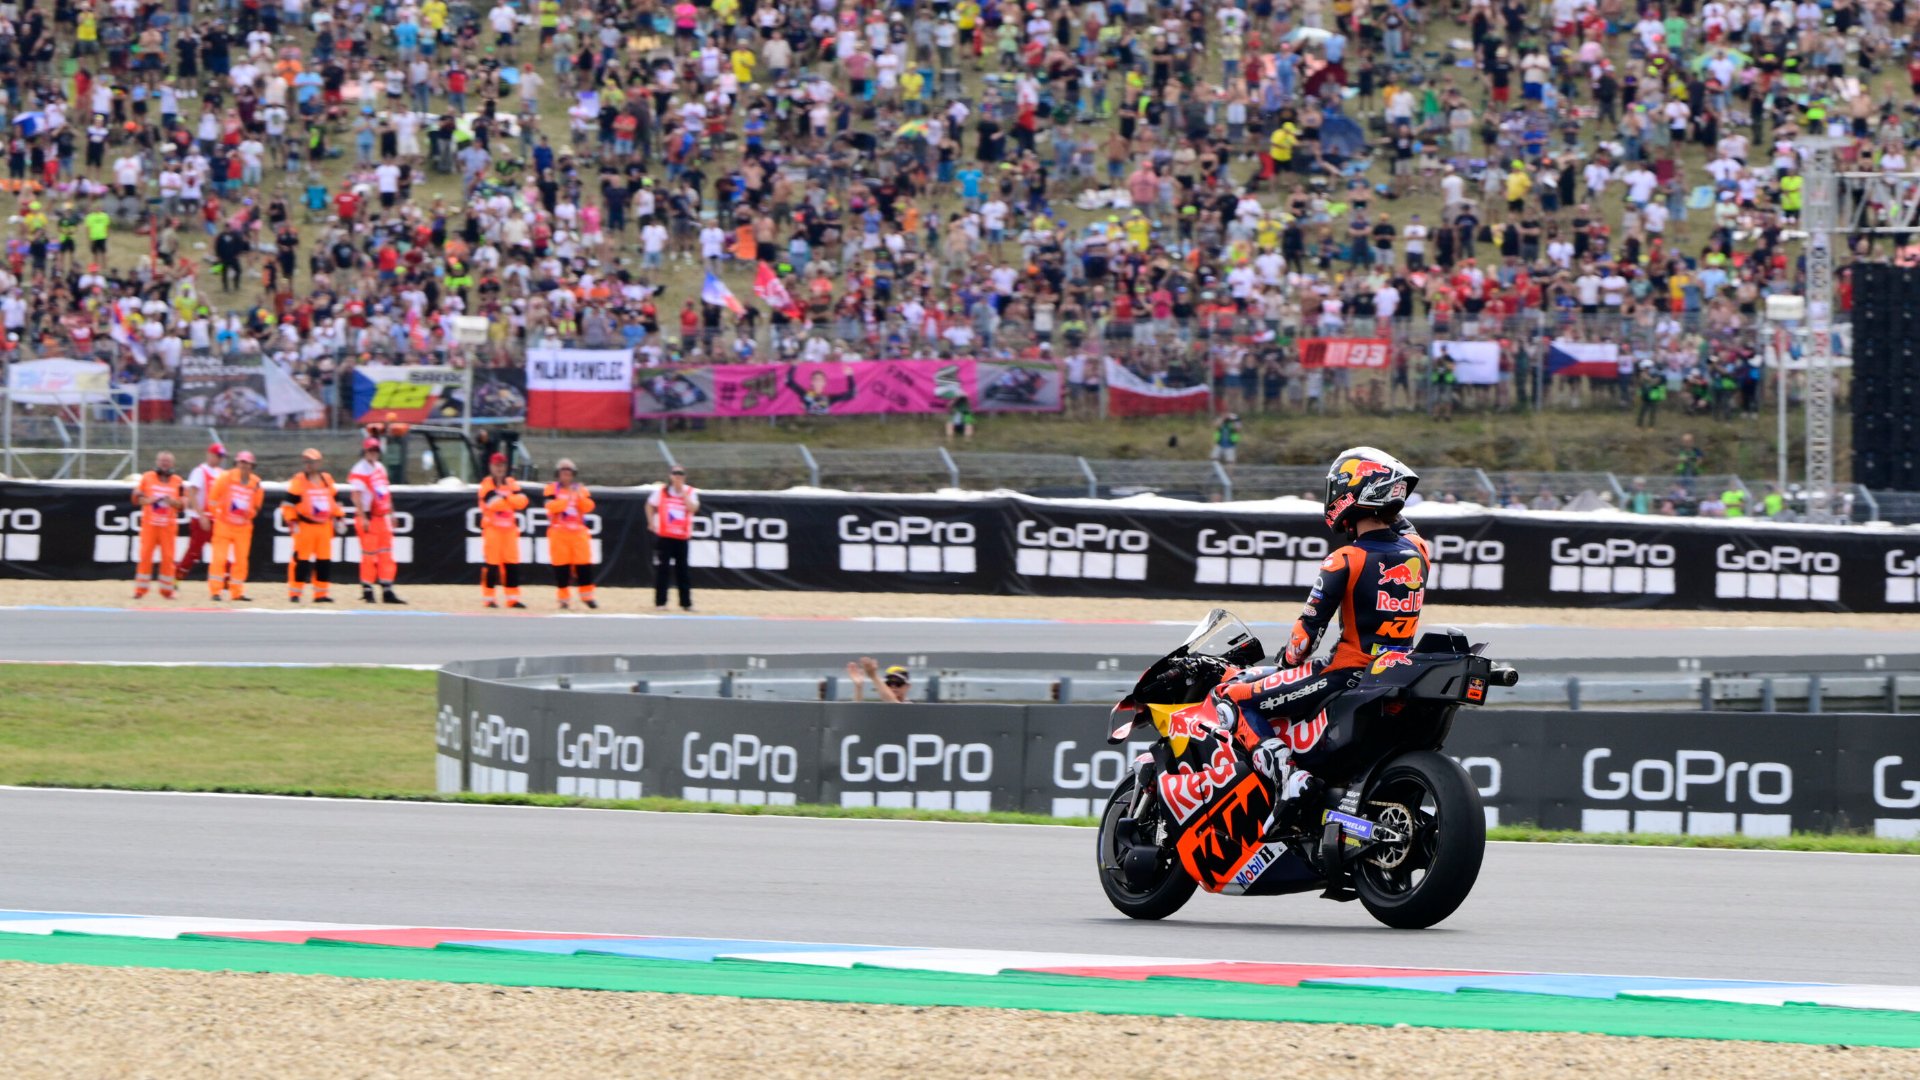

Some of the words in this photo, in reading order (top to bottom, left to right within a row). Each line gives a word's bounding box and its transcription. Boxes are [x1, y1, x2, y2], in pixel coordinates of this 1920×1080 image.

[691, 512, 788, 539] oPro
[839, 515, 976, 543] GoPro
[1017, 519, 1149, 551] GoPro
[1197, 529, 1329, 559] GoPro
[1551, 537, 1676, 567] GoPro
[1716, 543, 1840, 573] GoPro
[1376, 590, 1414, 612] Red
[1259, 678, 1328, 711] alpinestars
[470, 710, 530, 765] GoPro
[557, 722, 644, 772] GoPro
[682, 732, 798, 784] GoPro
[840, 734, 994, 782] GoPro
[1582, 748, 1793, 804] GoPro
[1159, 729, 1238, 826] Red
[1192, 785, 1273, 889] KTM
[1235, 855, 1265, 888] Mobil
[1259, 845, 1276, 864] 1
